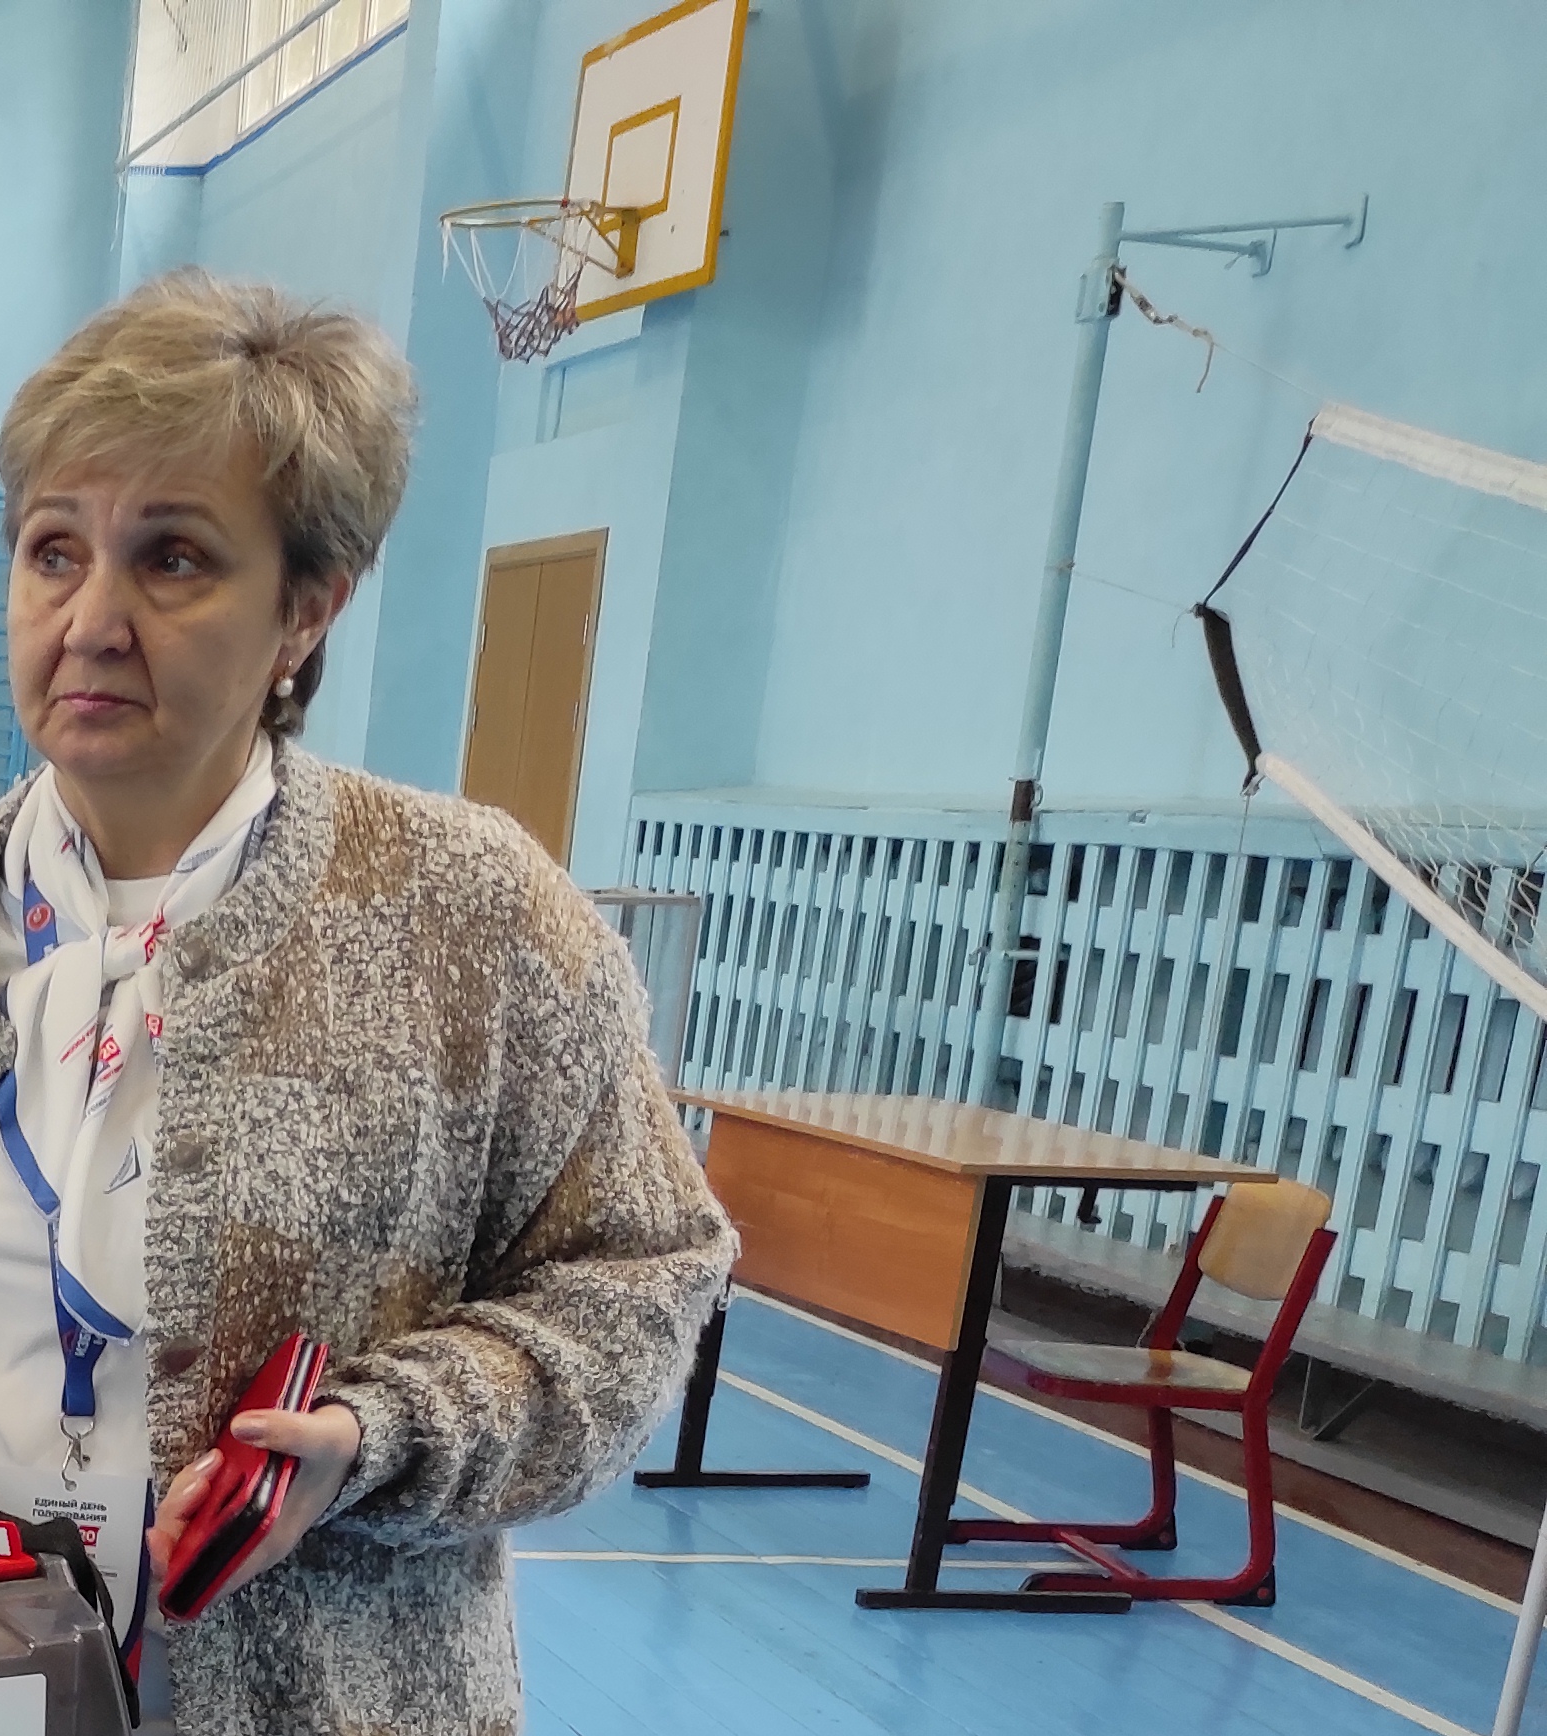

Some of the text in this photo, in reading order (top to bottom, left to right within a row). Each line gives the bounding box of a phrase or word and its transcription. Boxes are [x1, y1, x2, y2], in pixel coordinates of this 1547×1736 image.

[34, 1498, 107, 1511] ЕДИНЫЙ ДЕНЬ
[32, 1509, 107, 1522] ГОЛОСОВАНИЯ
